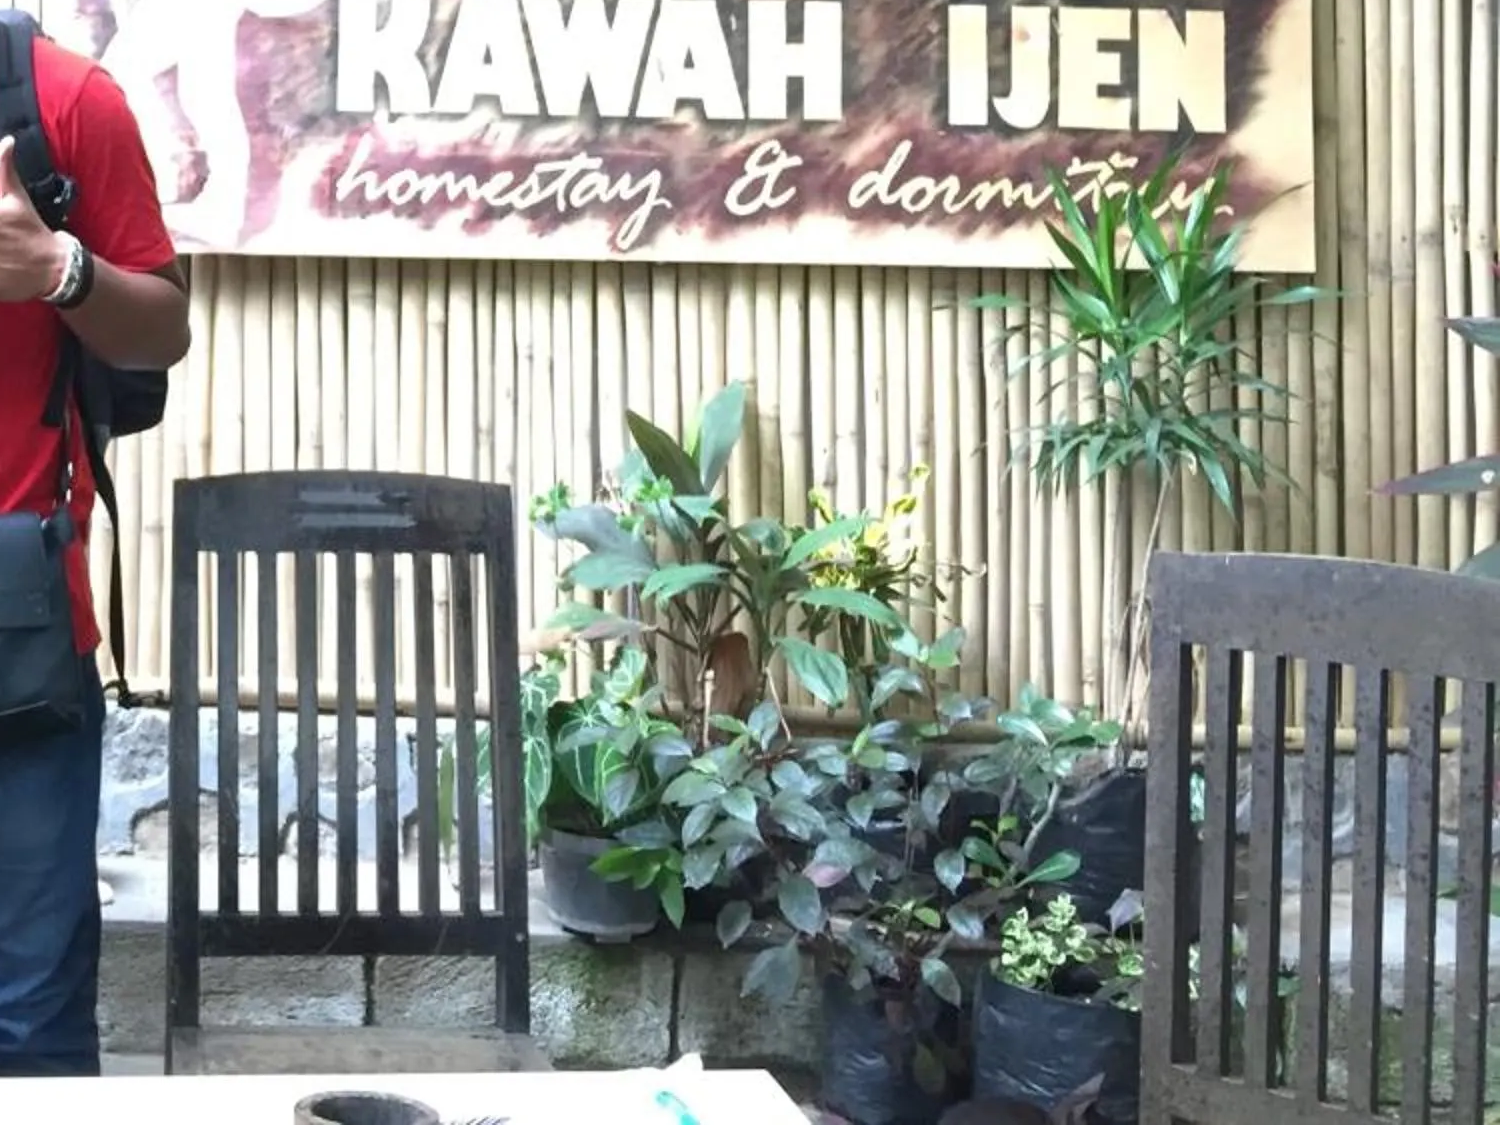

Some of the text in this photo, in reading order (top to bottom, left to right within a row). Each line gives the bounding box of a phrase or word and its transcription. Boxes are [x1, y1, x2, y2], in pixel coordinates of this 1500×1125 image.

[948, 3, 1227, 133] IJEN
[336, 133, 1235, 251] homestay & dormty
